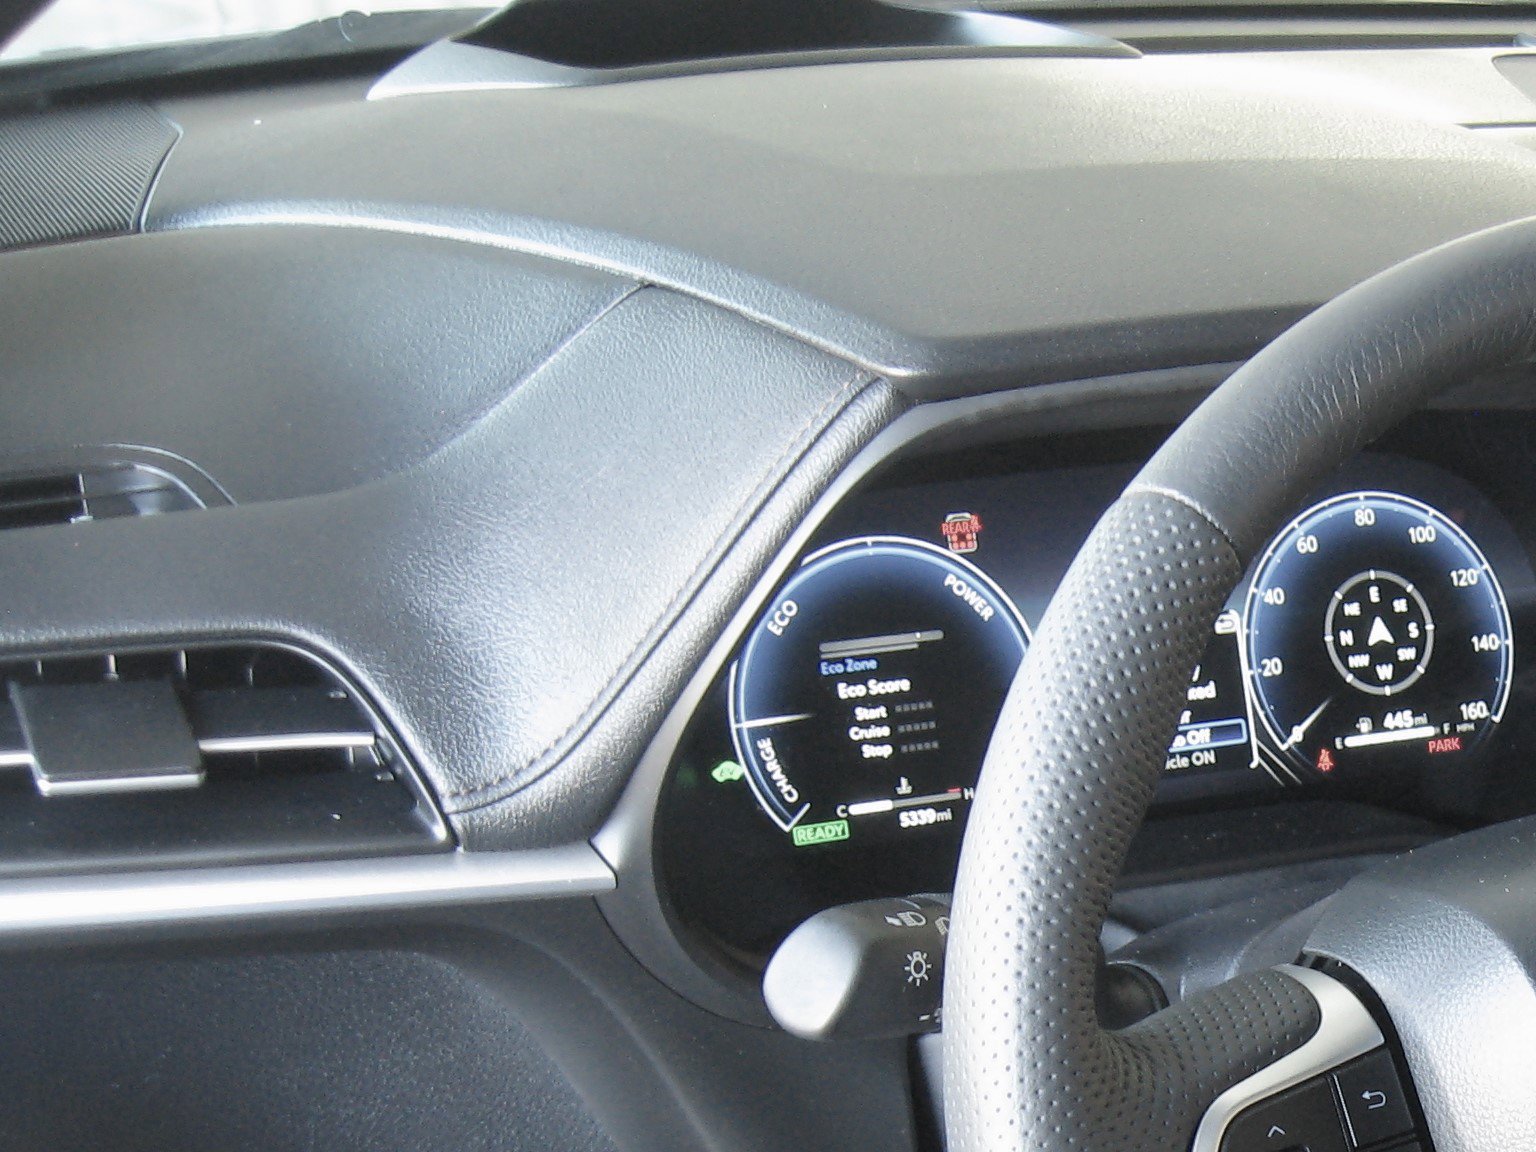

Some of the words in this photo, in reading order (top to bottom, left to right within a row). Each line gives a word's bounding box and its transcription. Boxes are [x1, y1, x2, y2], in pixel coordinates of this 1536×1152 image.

[1354, 509, 1375, 526] 80
[1408, 526, 1436, 544] 100
[1296, 536, 1318, 553] 60
[1450, 568, 1478, 587] 120
[943, 573, 995, 621] POWER
[1264, 588, 1285, 605] 40
[1369, 586, 1380, 602] E
[767, 599, 799, 636] ECO
[1340, 631, 1353, 646] N
[1471, 634, 1499, 652] 140
[820, 660, 844, 676] Eco
[845, 658, 878, 672] Zone
[1261, 658, 1282, 677] 20
[1375, 664, 1393, 680] W
[837, 682, 867, 699] Eco
[868, 678, 911, 696] Score
[854, 706, 888, 722] Start
[1460, 702, 1486, 720] 160
[849, 724, 891, 742] Cruise
[861, 743, 893, 760] Stop
[1428, 737, 1461, 753] PARK
[756, 737, 799, 804] CHARGE
[797, 823, 845, 842] READY
